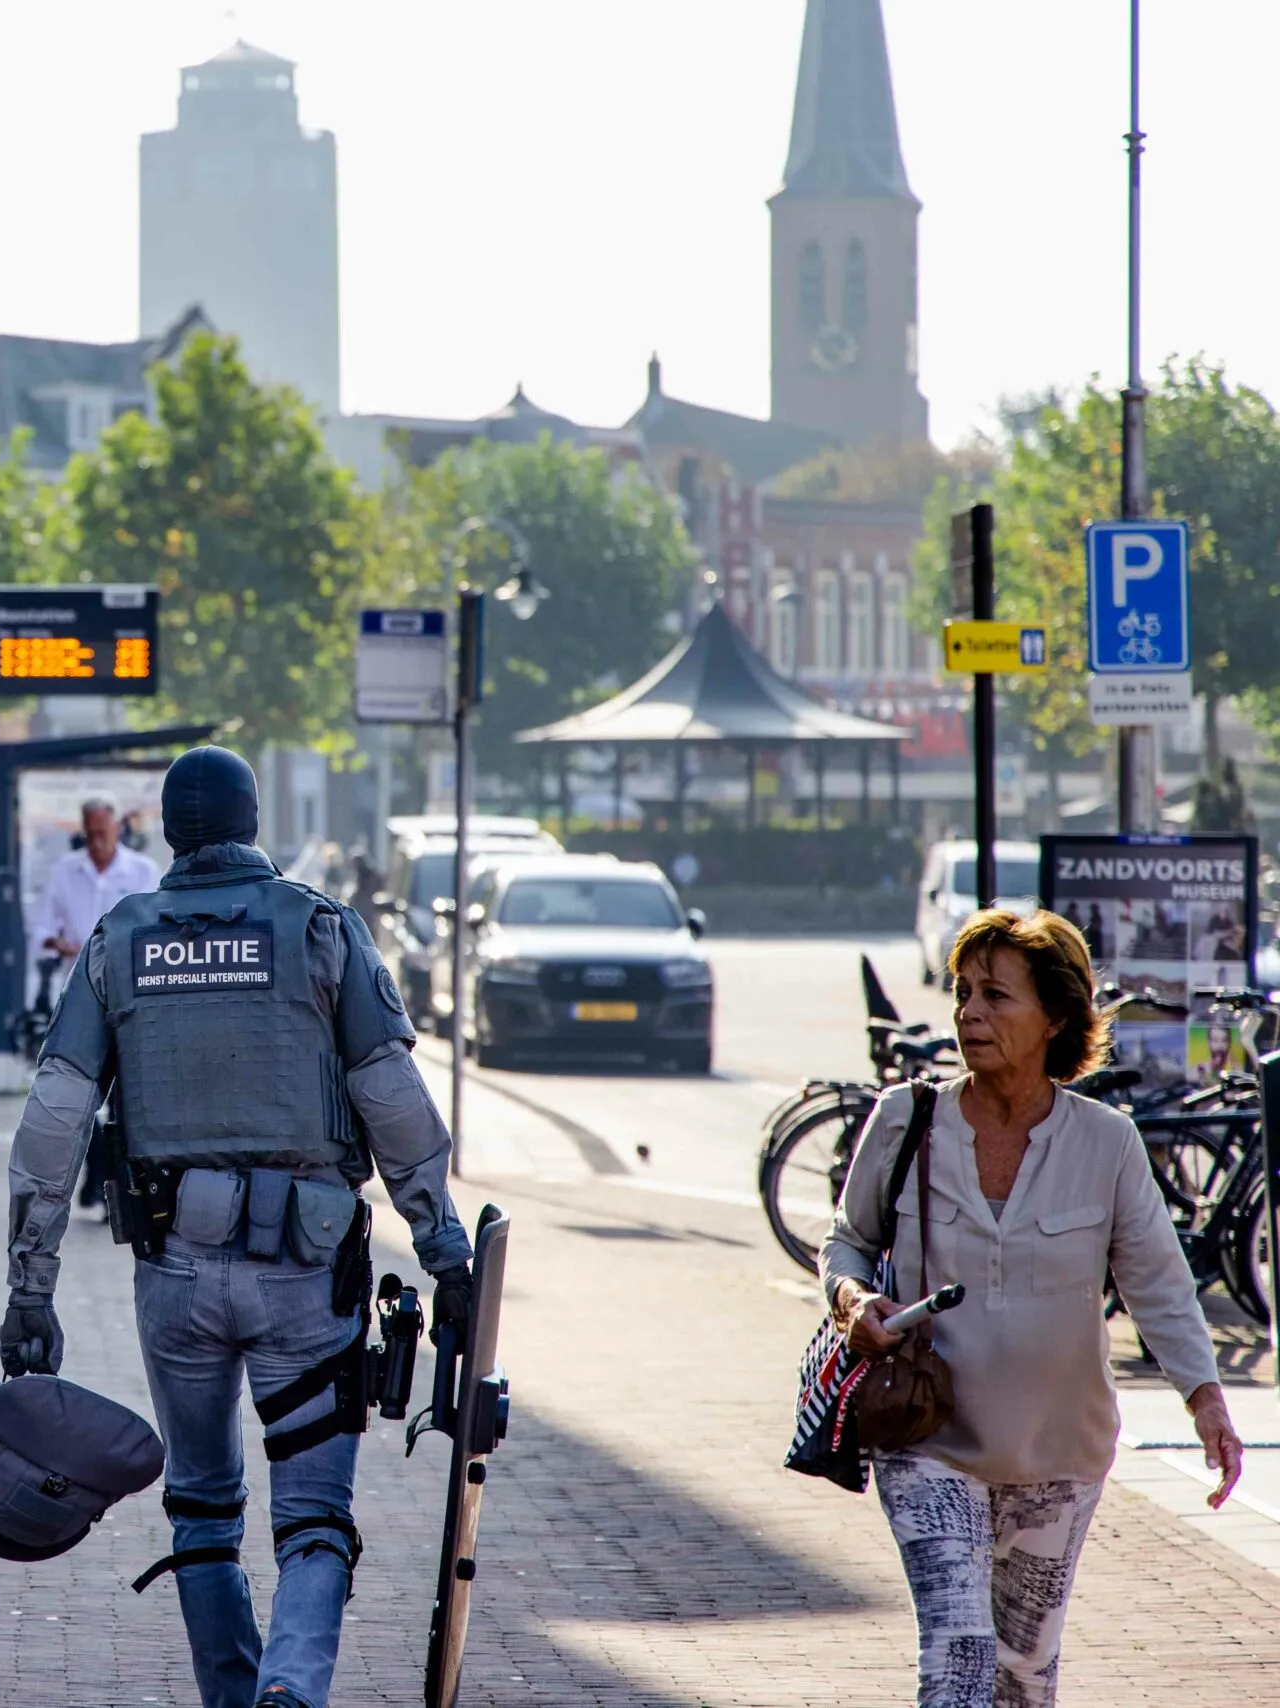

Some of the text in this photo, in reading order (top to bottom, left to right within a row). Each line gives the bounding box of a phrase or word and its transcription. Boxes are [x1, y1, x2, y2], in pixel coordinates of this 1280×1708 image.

[1112, 533, 1164, 608] P
[1057, 857, 1245, 882] ZANDVOORTS
[1172, 883, 1245, 900] MUSEUM
[145, 940, 260, 967] POLITIE
[137, 971, 269, 987] DIENST SPECIALE INTERVENTIES
